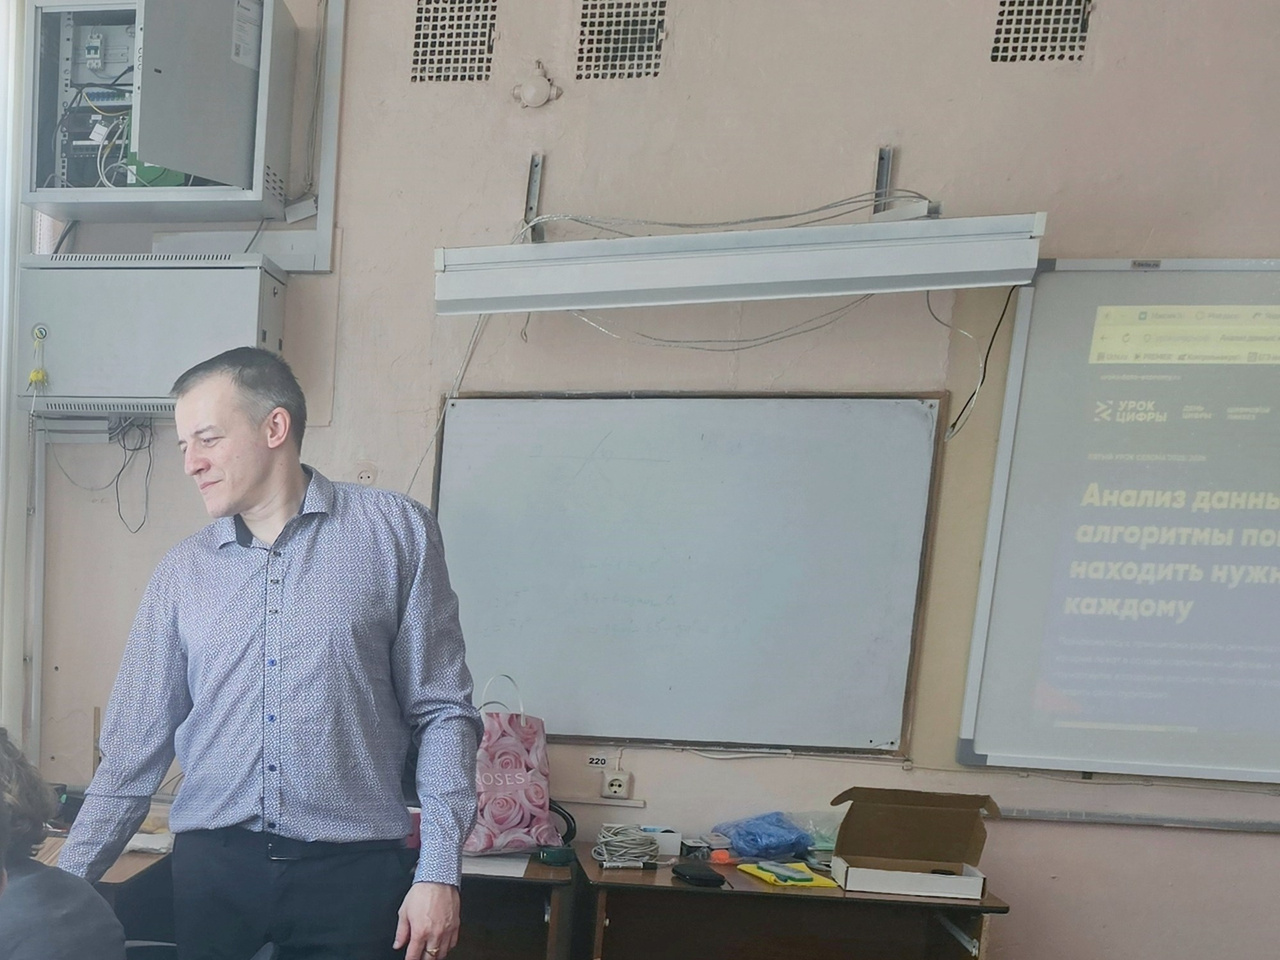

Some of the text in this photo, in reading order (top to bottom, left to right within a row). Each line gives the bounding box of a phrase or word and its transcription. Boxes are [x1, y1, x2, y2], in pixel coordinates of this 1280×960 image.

[1116, 412, 1168, 424] ЦИФРЫ
[1118, 401, 1156, 411] УРОК
[1080, 482, 1187, 509] Анализ
[1075, 524, 1280, 550] алгоритмы по
[1070, 560, 1204, 585] находить
[1064, 597, 1195, 625] каждому
[588, 757, 606, 766] 220
